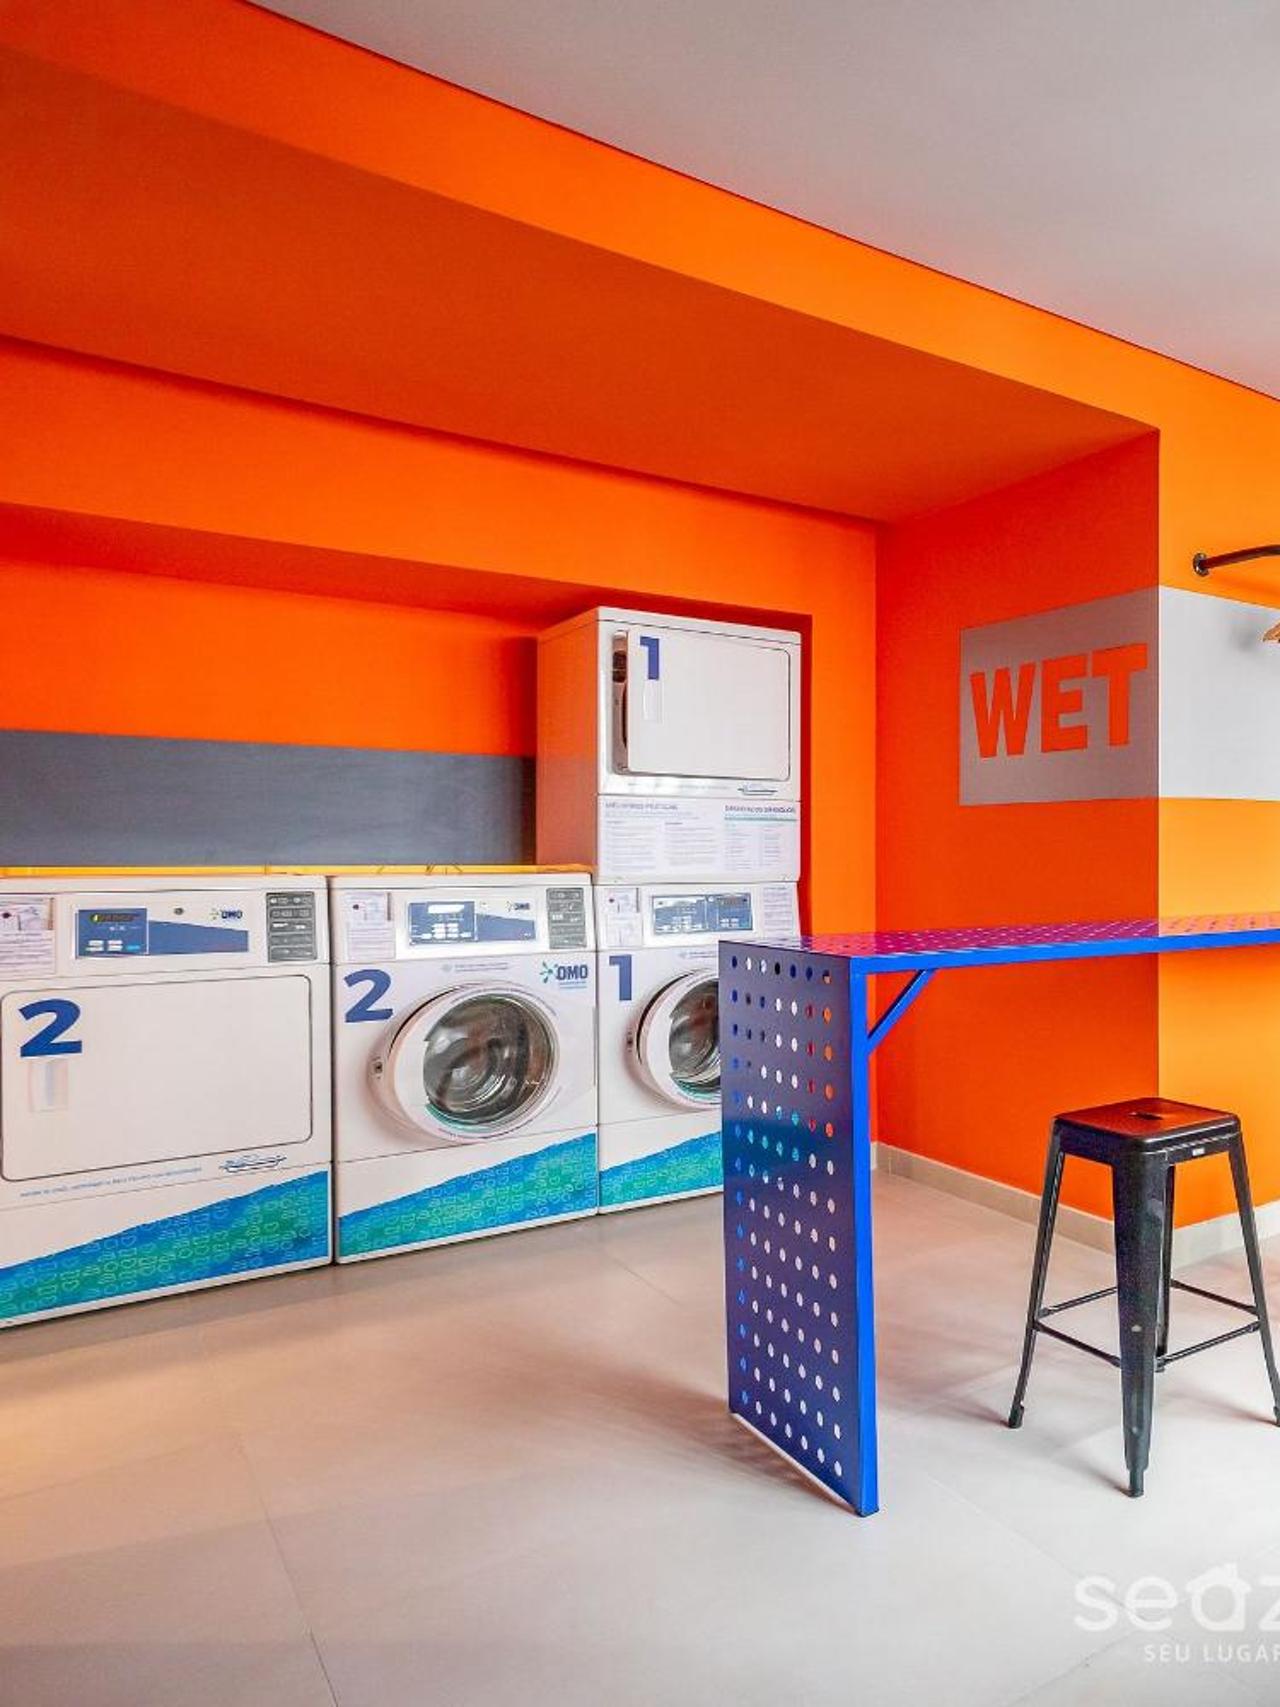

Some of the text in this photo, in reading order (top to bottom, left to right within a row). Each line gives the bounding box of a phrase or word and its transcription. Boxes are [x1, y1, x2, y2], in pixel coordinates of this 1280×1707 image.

[639, 636, 660, 680] 1
[970, 642, 1148, 759] WET
[343, 968, 394, 1023] 2
[556, 965, 588, 980] OMO
[609, 954, 632, 1001] 1
[18, 998, 83, 1058] 2
